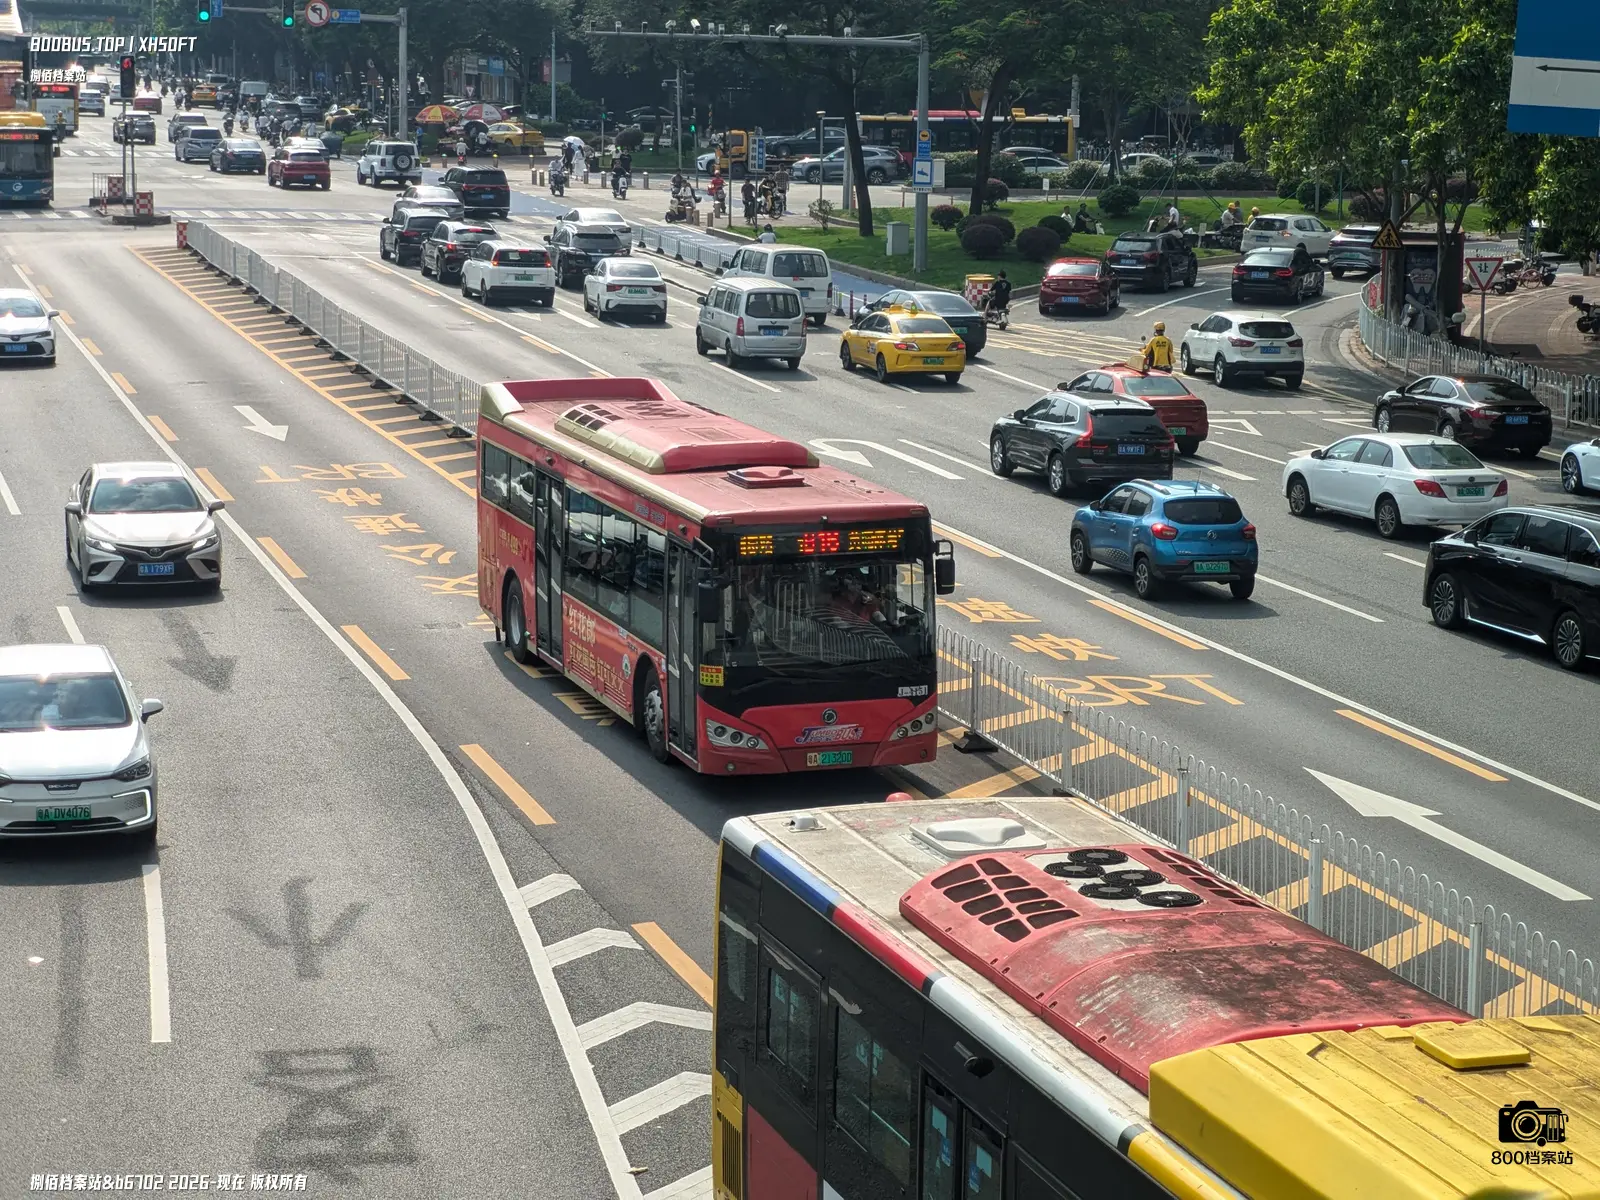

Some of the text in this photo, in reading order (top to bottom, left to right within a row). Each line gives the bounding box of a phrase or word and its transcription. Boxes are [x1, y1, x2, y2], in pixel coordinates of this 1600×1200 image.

[1478, 262, 1489, 273] 让
[255, 462, 408, 483] BRT
[1024, 674, 1245, 706] BRT
